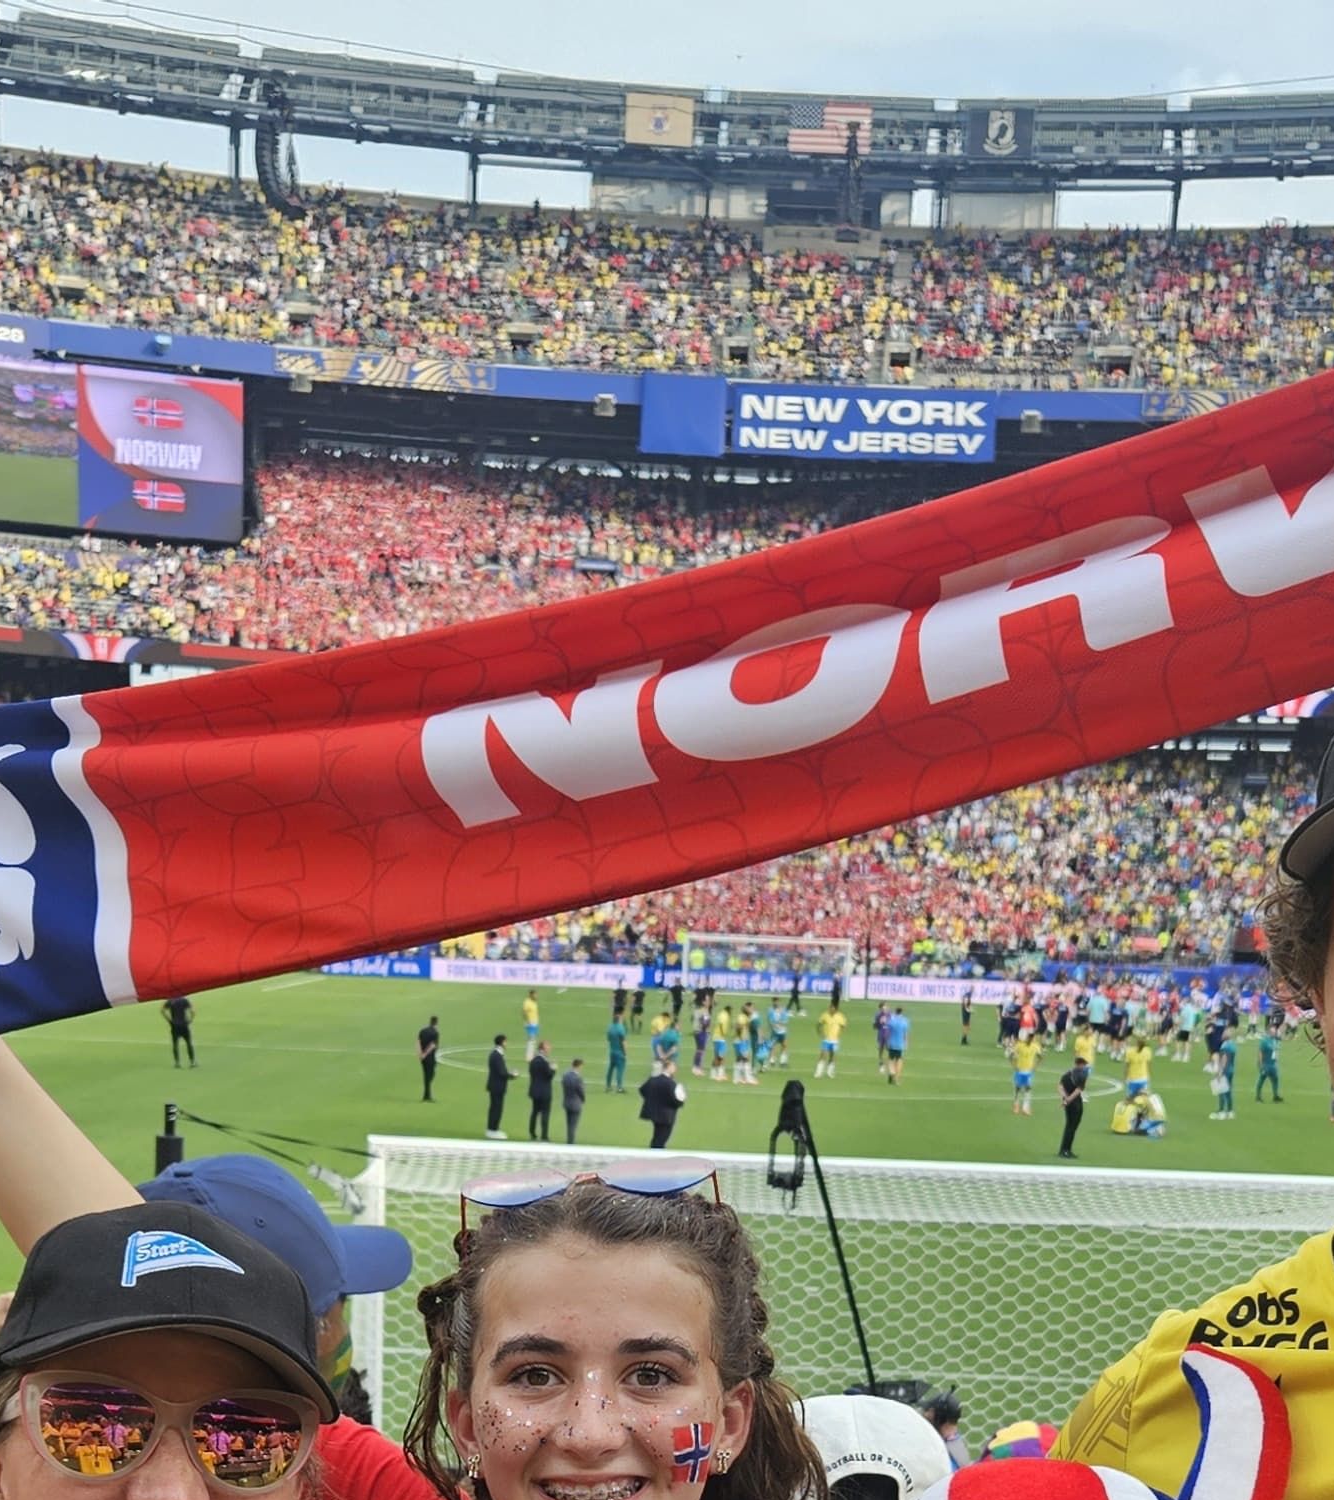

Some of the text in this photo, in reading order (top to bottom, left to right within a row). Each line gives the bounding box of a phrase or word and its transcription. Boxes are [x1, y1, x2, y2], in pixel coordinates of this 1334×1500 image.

[741, 394, 987, 427] NEW YORK
[115, 438, 202, 471] NORWAY
[739, 426, 986, 455] NEW JERSEY
[136, 1240, 198, 1262] Start
